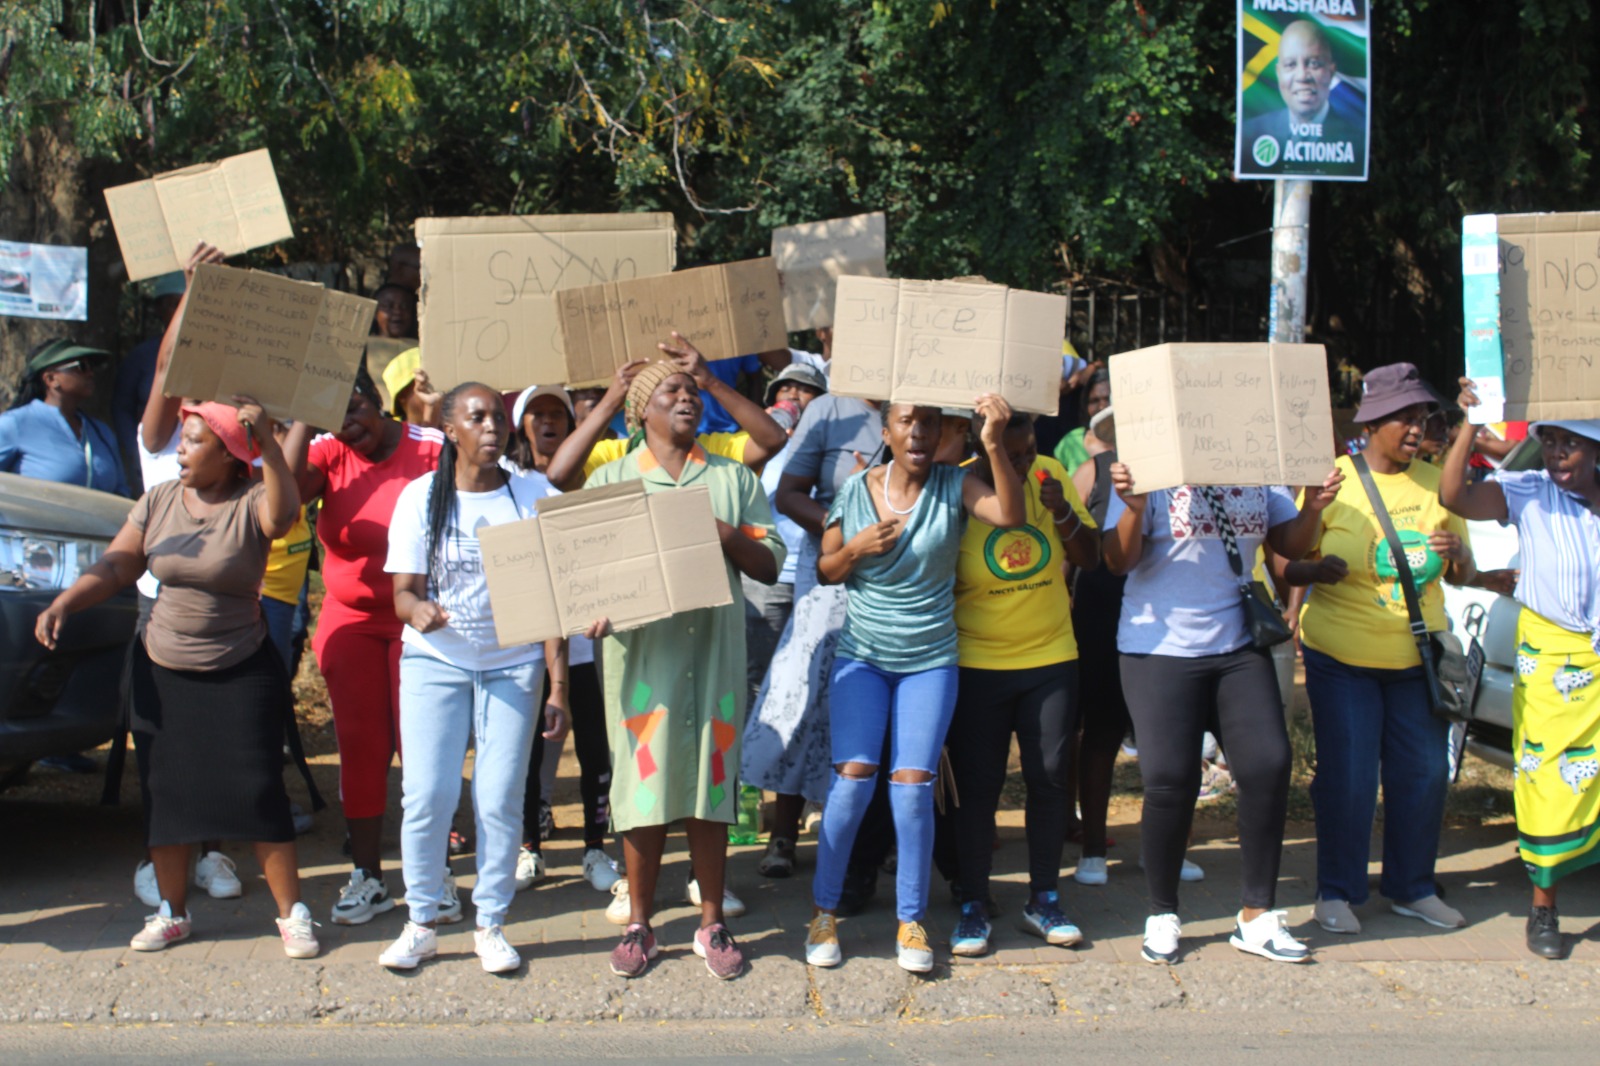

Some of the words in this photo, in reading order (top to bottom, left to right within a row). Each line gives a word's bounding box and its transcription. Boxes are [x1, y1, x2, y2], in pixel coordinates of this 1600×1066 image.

[1252, 0, 1357, 16] MASHABA
[1290, 124, 1323, 137] VOTE
[1284, 140, 1355, 163] ACTIONSA
[487, 250, 573, 306] SAY
[1543, 256, 1598, 292] NO
[198, 271, 231, 292] WE
[237, 278, 271, 298] ARE
[278, 287, 319, 307] TIRED
[230, 298, 259, 312] WHO
[265, 304, 309, 322] KILLED
[246, 318, 301, 339] ENOUGH
[445, 316, 511, 363] TO
[256, 334, 291, 351] MEN
[198, 339, 218, 352] NO
[223, 343, 258, 359] BAIL
[266, 352, 299, 373] FOR
[1509, 354, 1593, 376] OMEN
[1174, 367, 1223, 391] Should
[1394, 515, 1417, 530] OTE
[446, 556, 481, 575] adi
